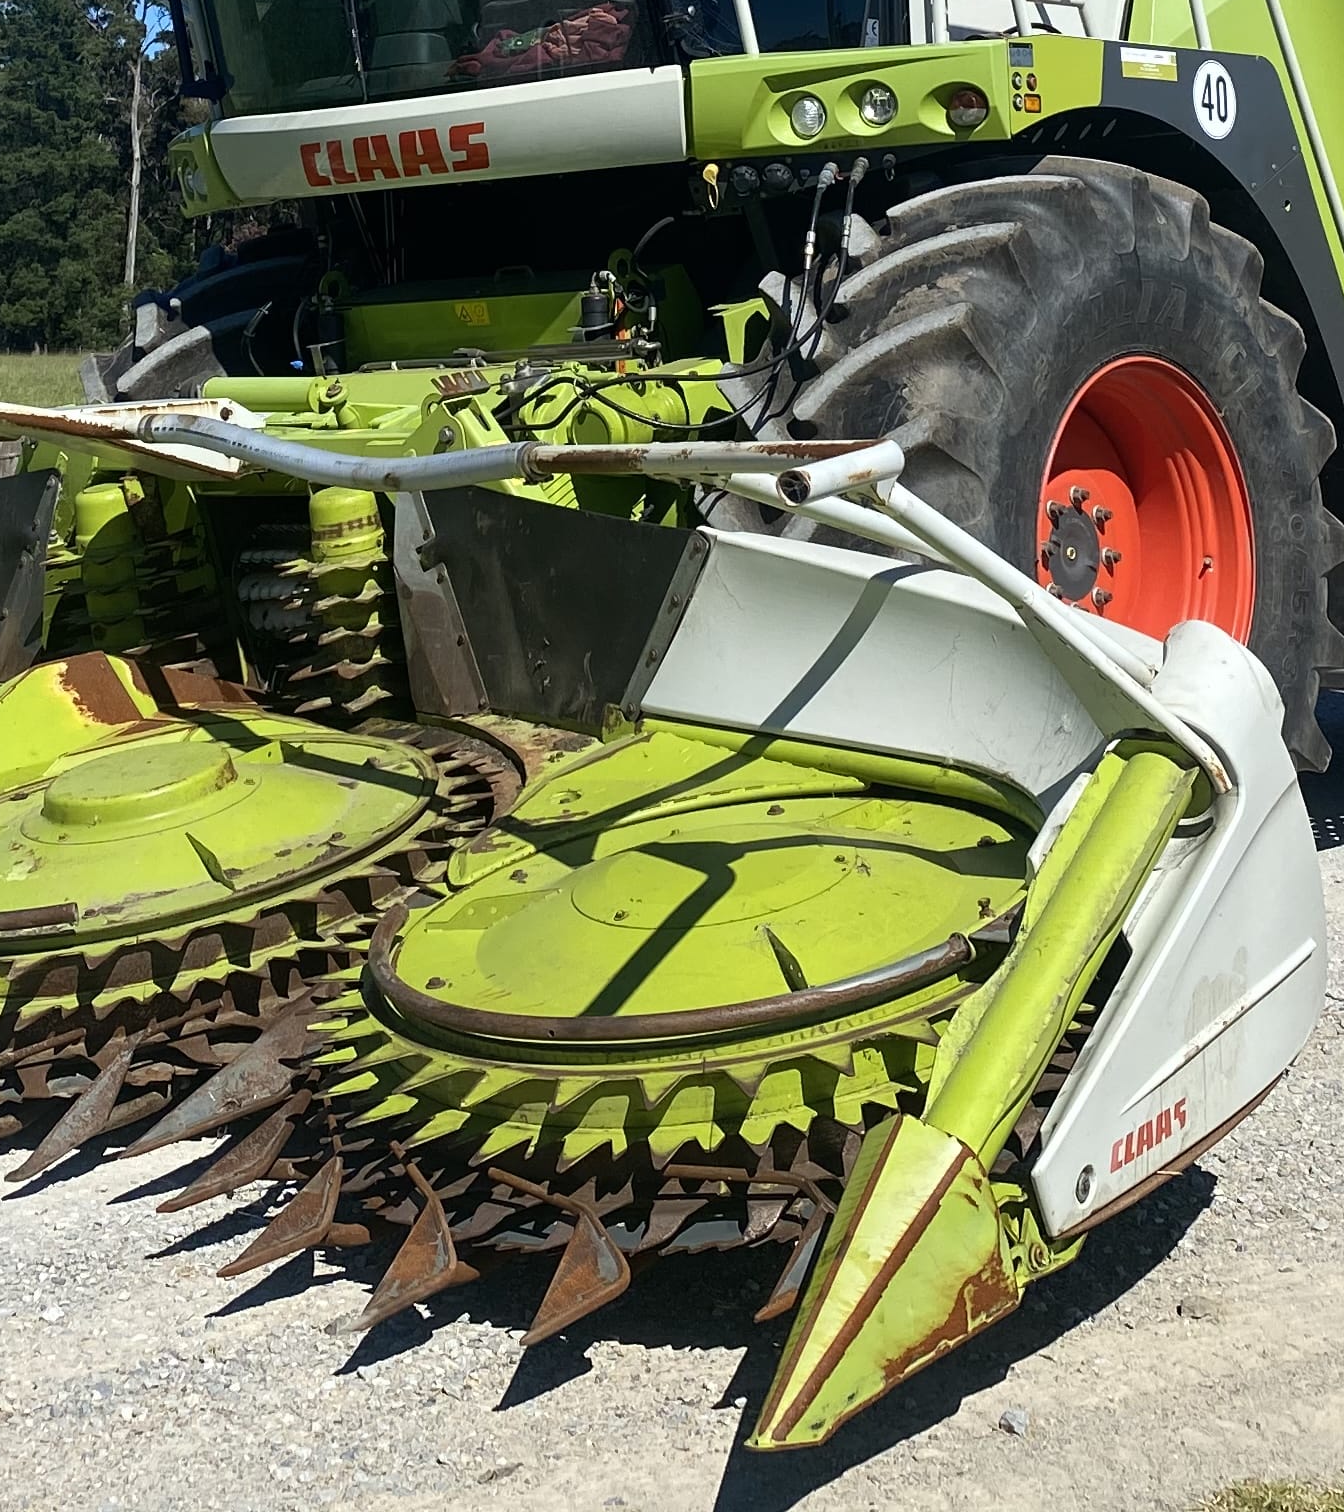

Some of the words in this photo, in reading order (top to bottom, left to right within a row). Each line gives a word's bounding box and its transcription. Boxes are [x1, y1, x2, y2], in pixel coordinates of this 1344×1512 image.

[1201, 73, 1228, 123] 40
[300, 122, 490, 187] CLAAS
[1110, 1097, 1187, 1174] CLAAS
